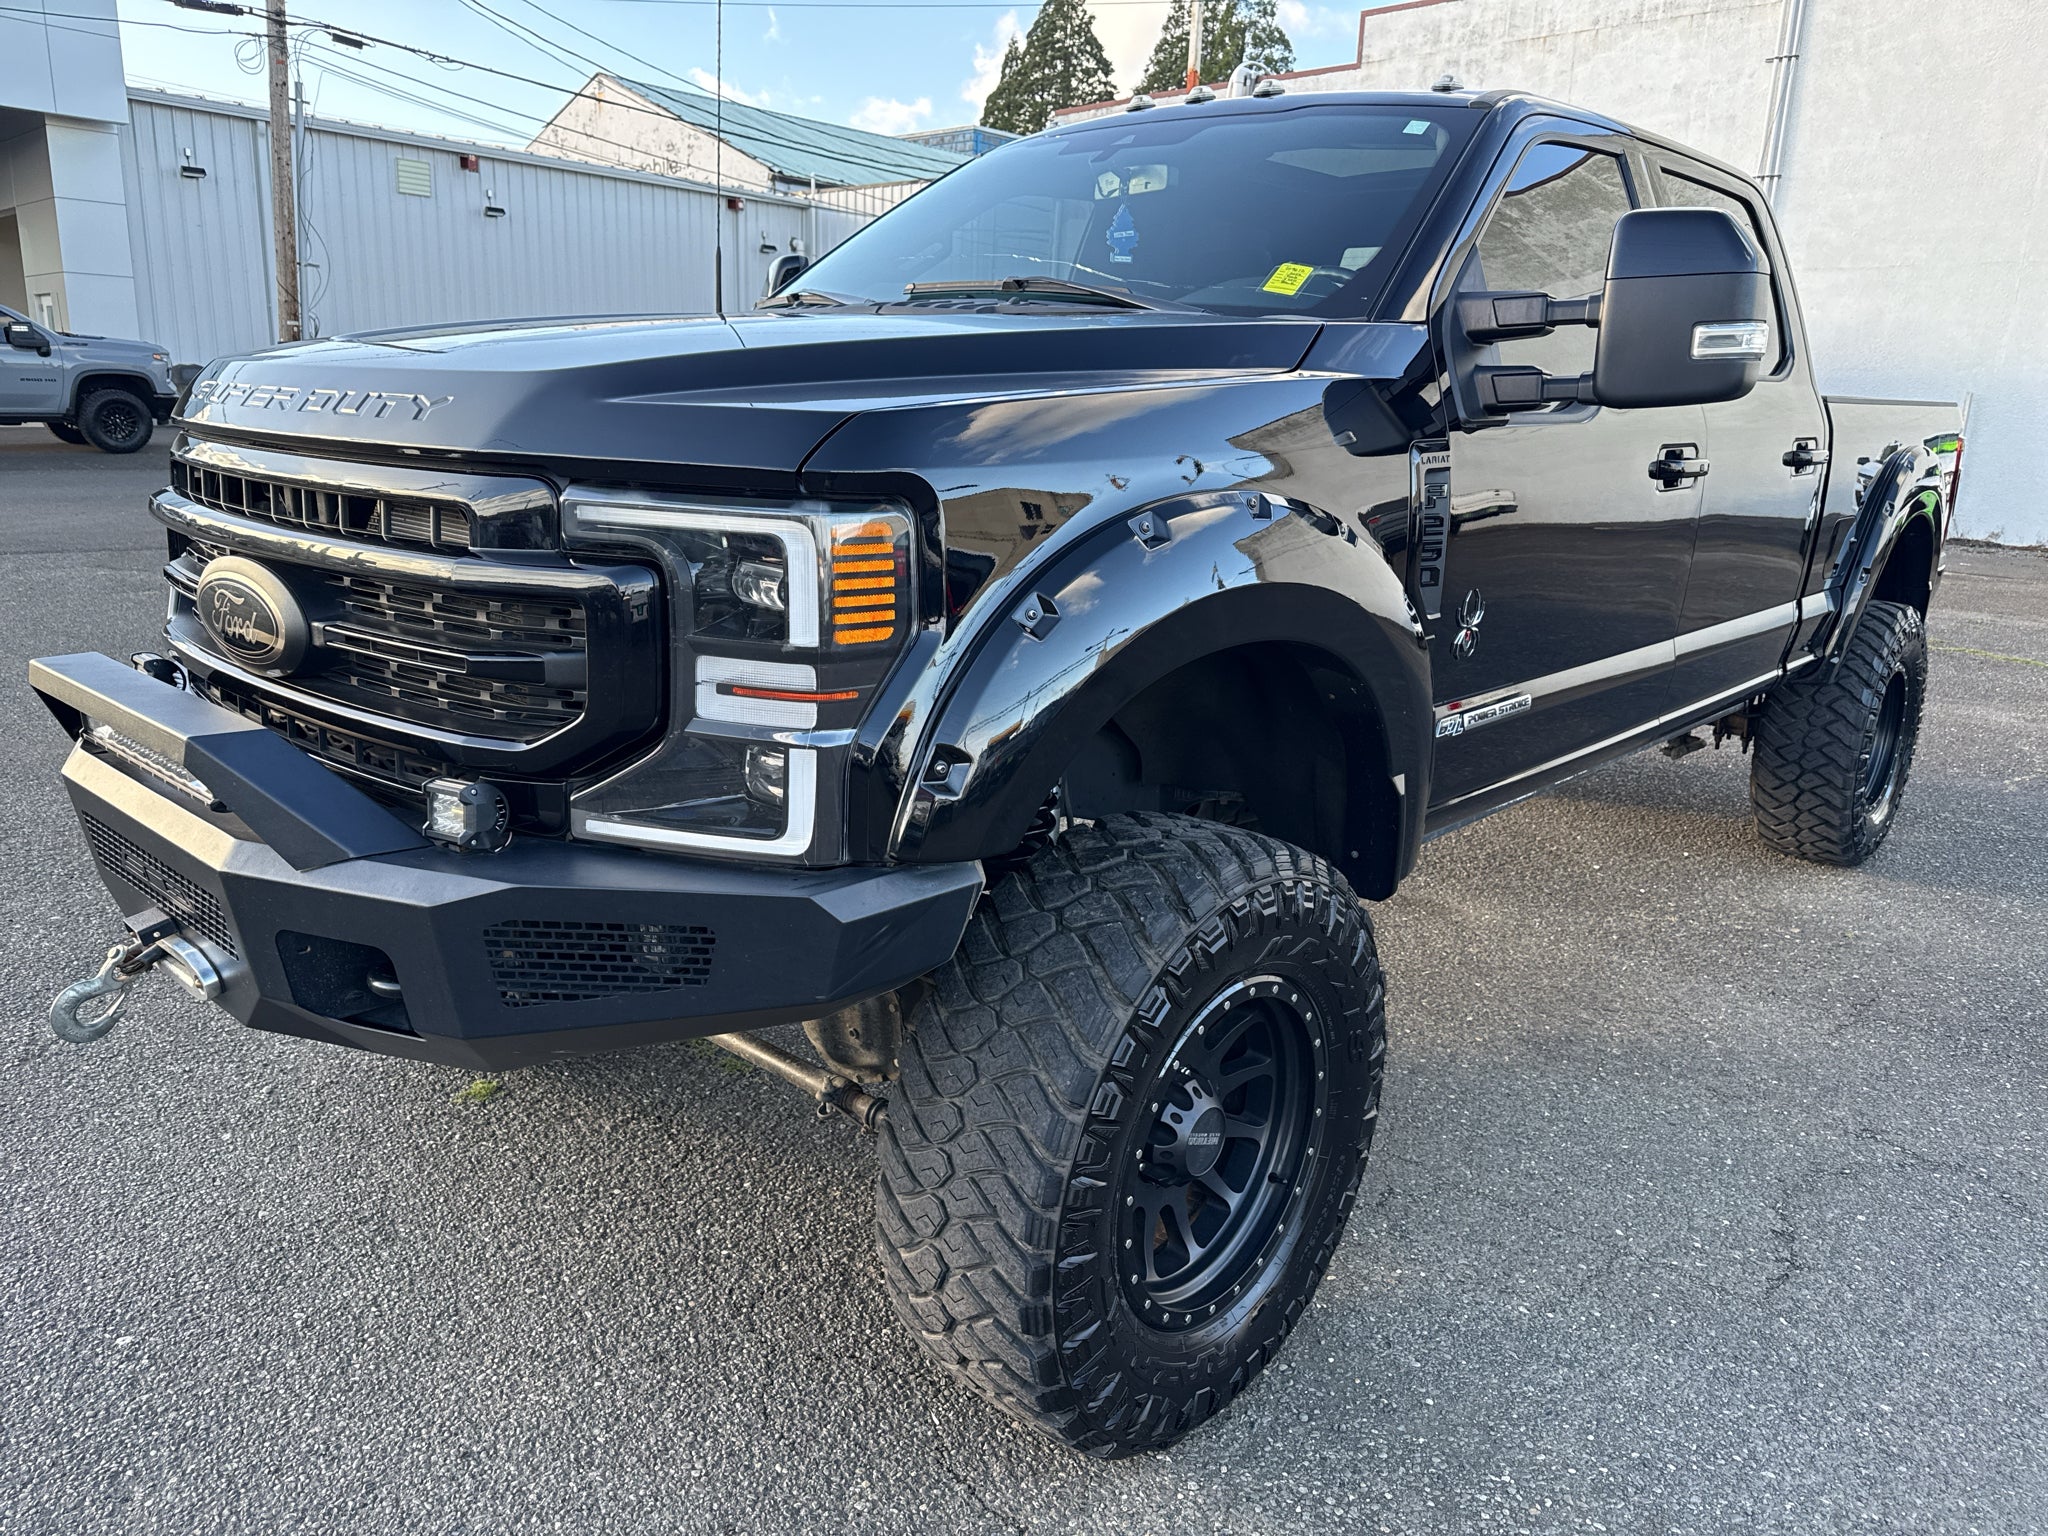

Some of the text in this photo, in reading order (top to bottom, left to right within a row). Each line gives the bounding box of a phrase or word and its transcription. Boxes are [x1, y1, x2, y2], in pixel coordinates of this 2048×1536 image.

[298, 387, 454, 422] DUTY
[1421, 454, 1450, 465] LARIAT
[211, 587, 257, 645] Ford
[1467, 708, 1498, 725] POWER
[1498, 697, 1530, 715] STROKE
